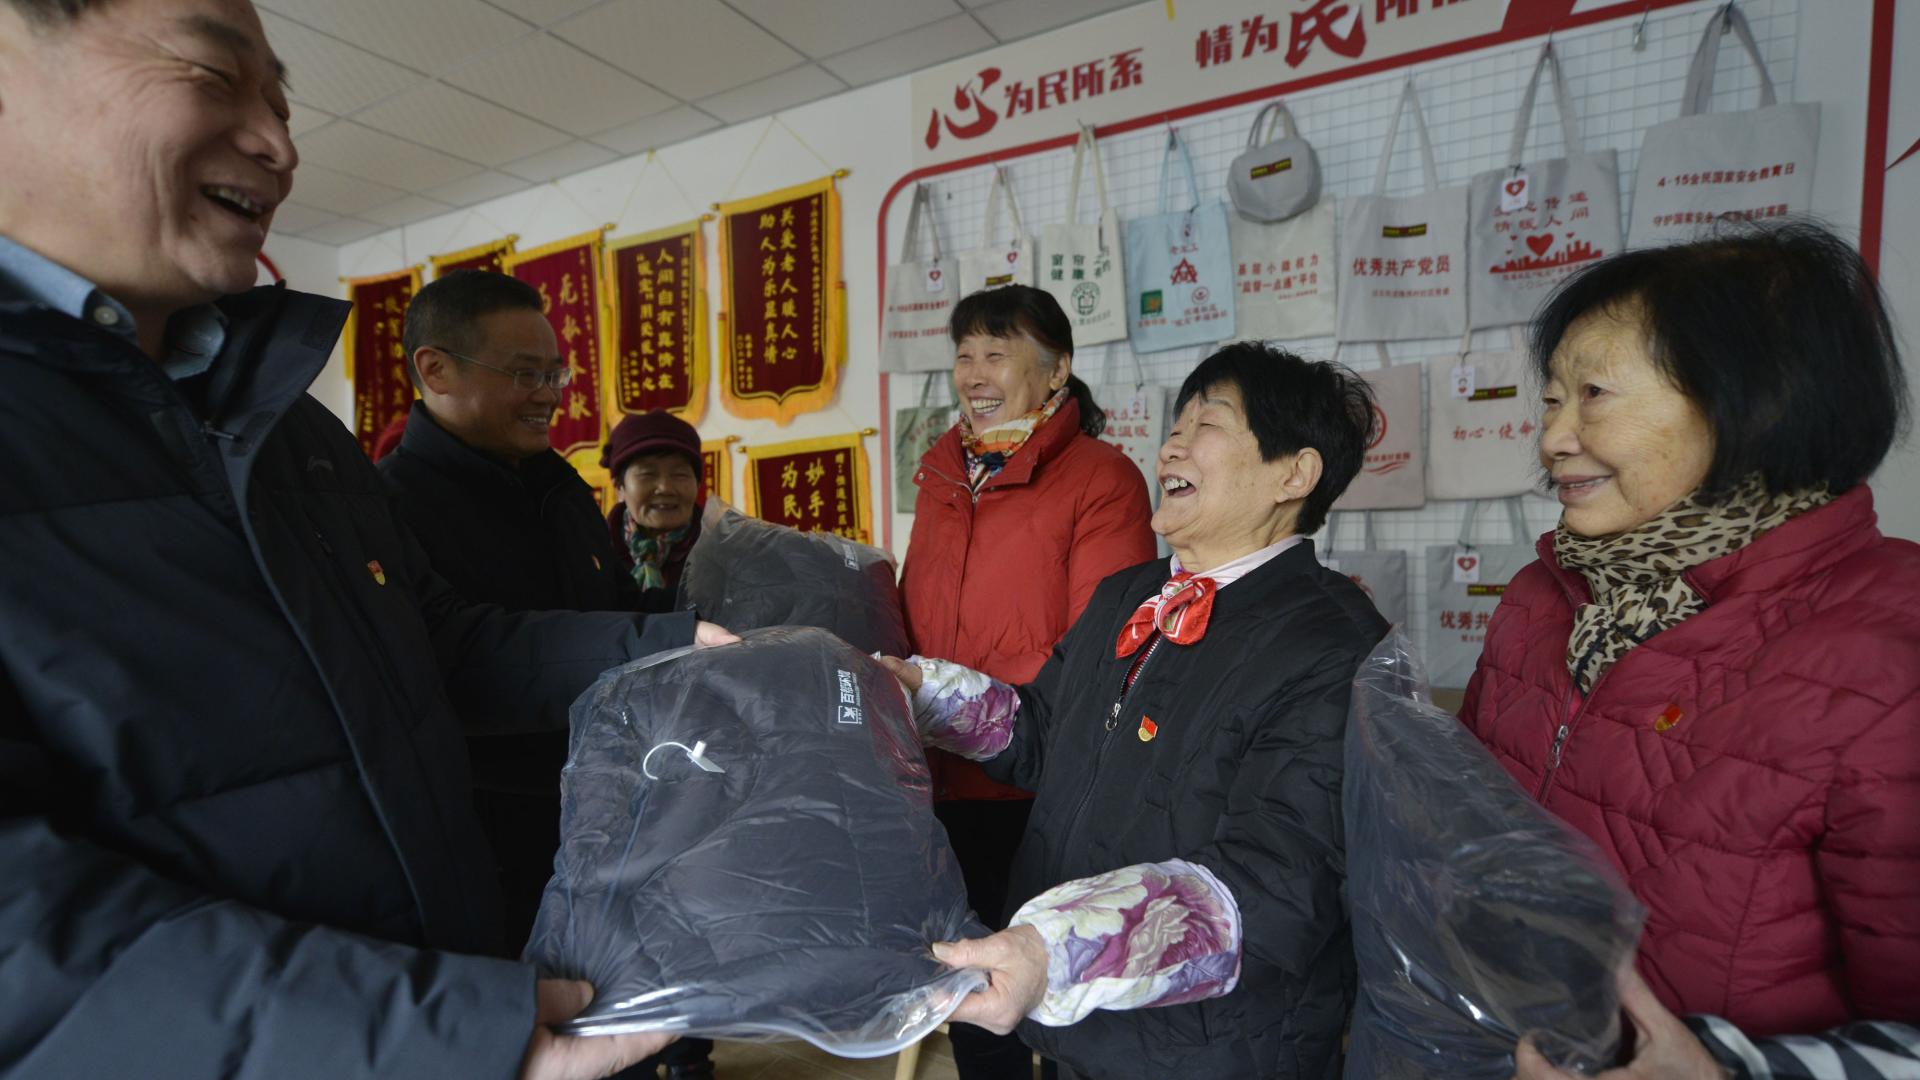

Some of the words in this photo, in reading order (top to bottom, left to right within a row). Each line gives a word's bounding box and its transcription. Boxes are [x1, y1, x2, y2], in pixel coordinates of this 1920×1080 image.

[1196, 0, 1472, 69] 情为民
[925, 47, 1144, 150] 心为民所系
[759, 213, 778, 365] 助人为乐显真情
[1353, 254, 1450, 276] 优秀共产党员
[559, 273, 593, 421] 无私奉献
[656, 247, 676, 390] 人间自有真情在
[781, 460, 803, 531] 为民
